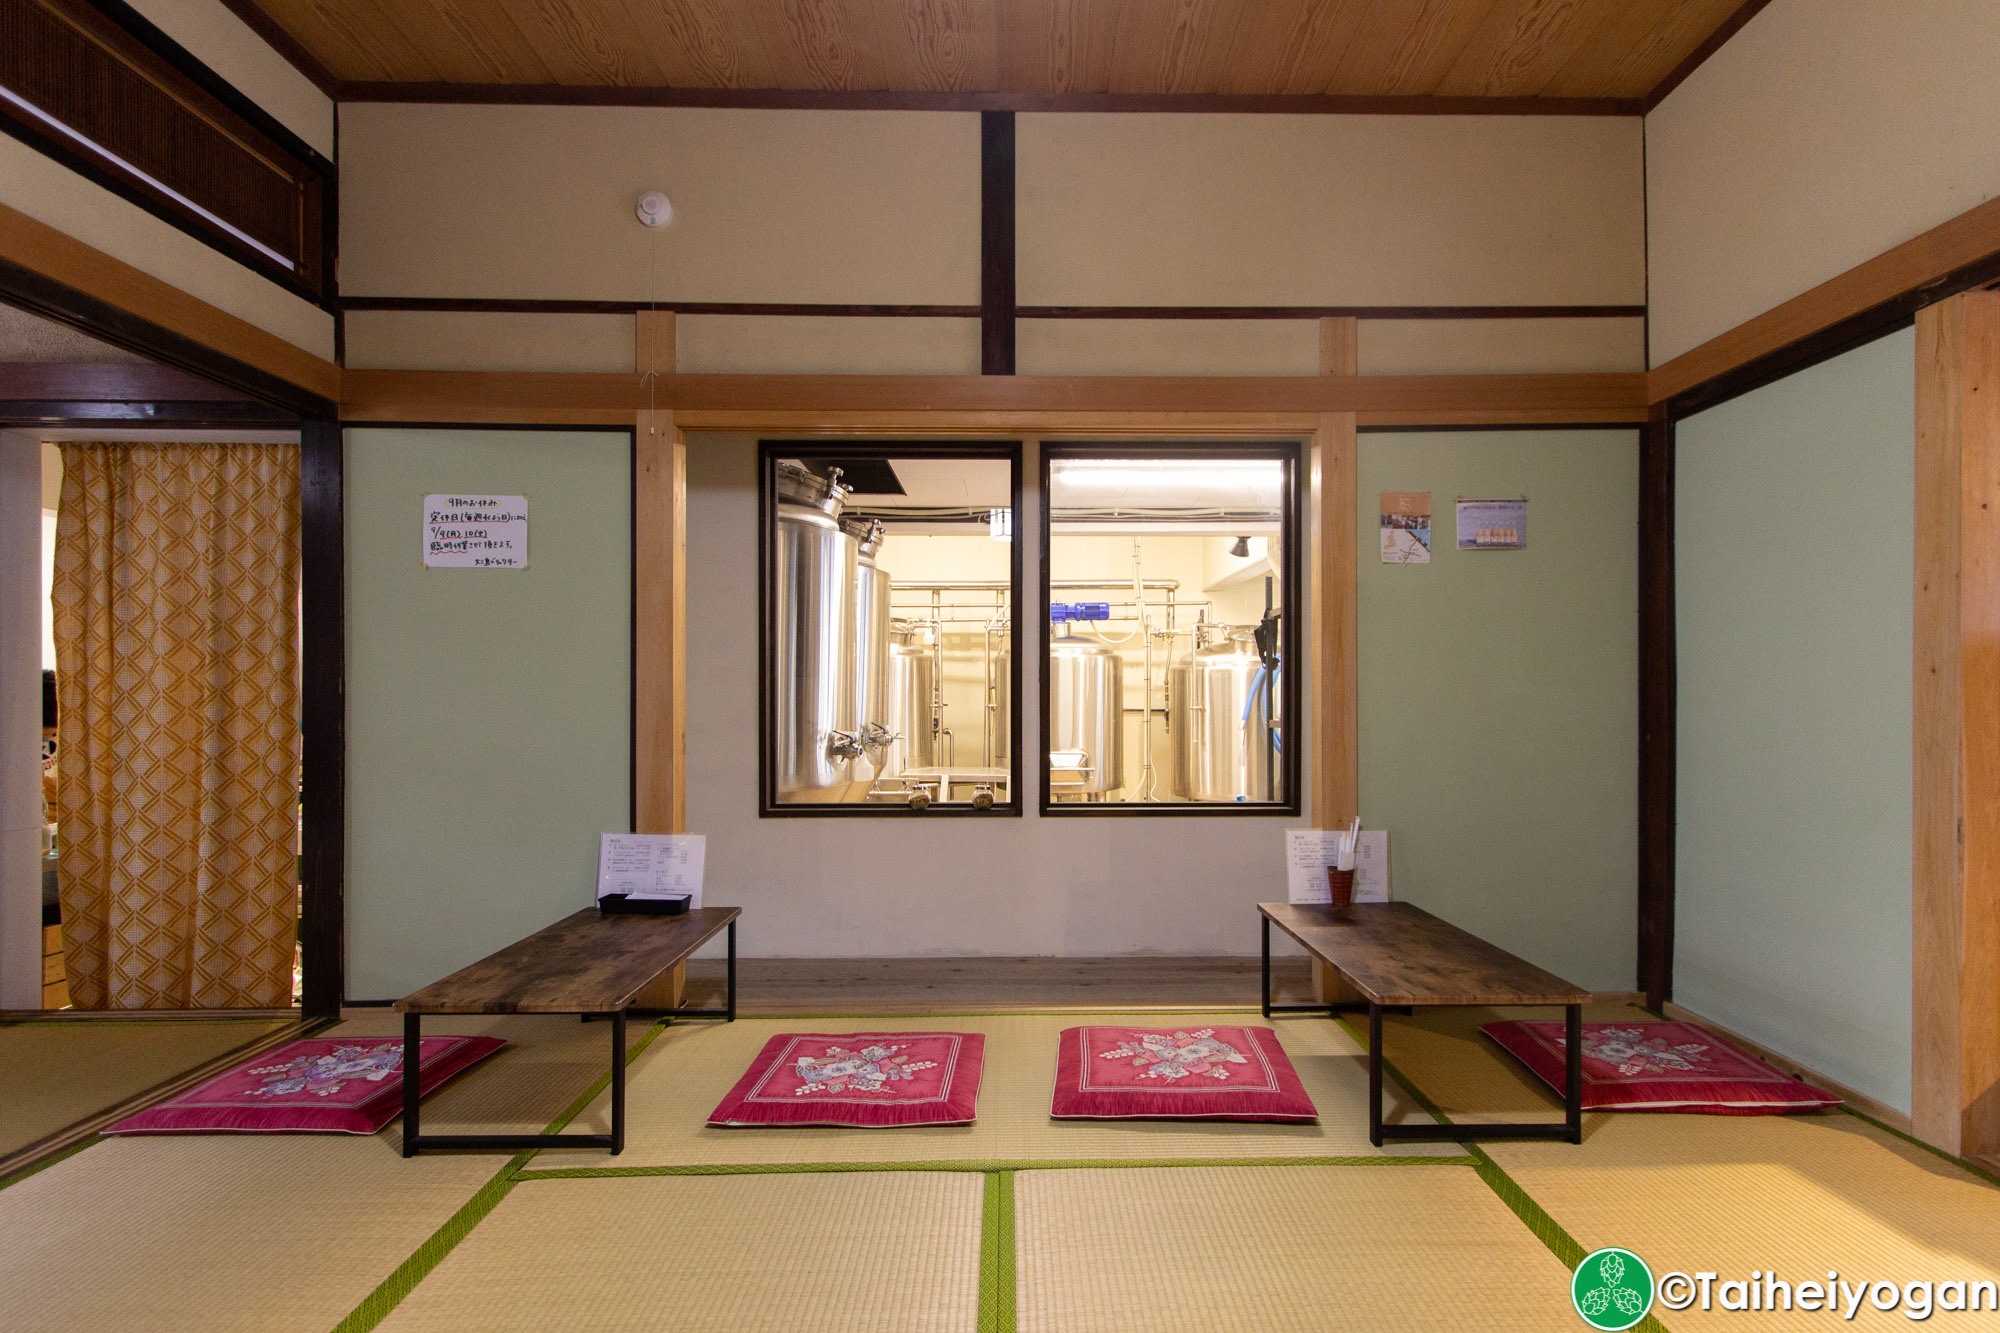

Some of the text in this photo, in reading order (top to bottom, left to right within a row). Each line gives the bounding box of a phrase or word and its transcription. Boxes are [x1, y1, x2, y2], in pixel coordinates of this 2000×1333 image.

[448, 497, 498, 508] 9月のお休み
